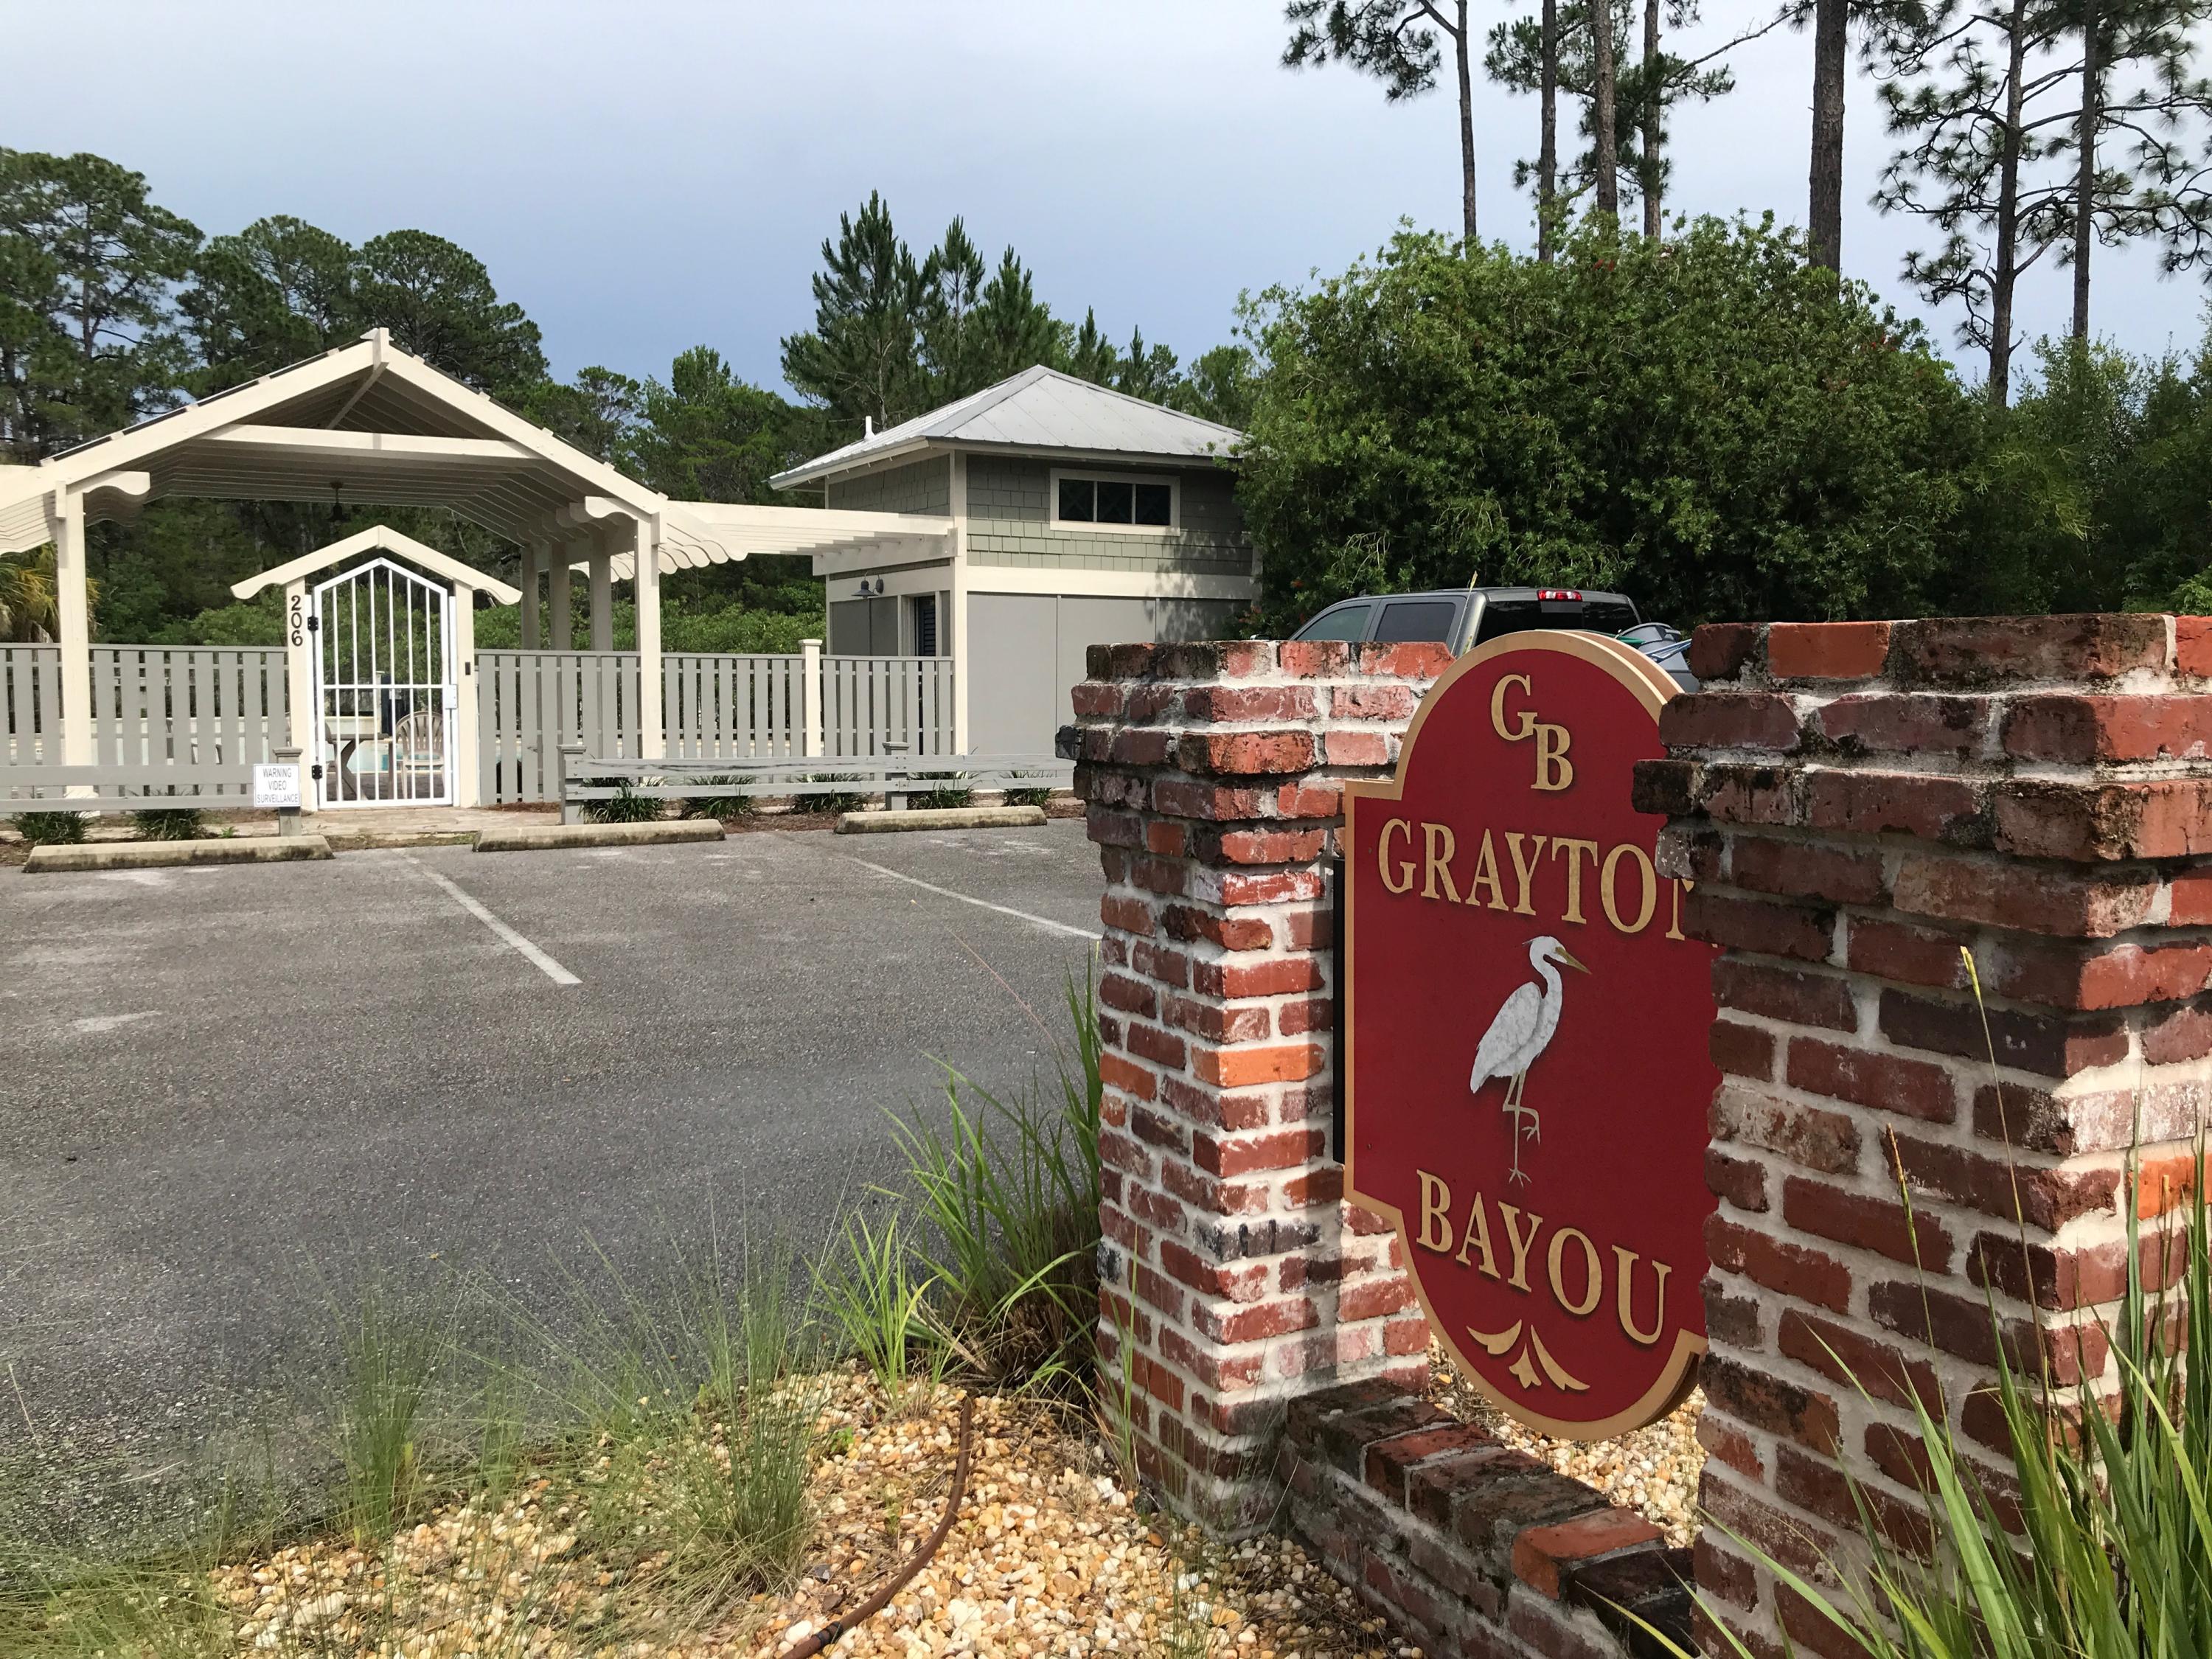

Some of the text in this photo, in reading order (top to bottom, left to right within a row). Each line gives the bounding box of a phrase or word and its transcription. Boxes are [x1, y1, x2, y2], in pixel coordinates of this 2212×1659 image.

[291, 594, 304, 647] 206
[262, 768, 292, 778] WARNING
[268, 780, 287, 790] VIDEO
[257, 793, 299, 803] SURVEILLANCE
[1416, 1169, 1672, 1344] BAYOU
